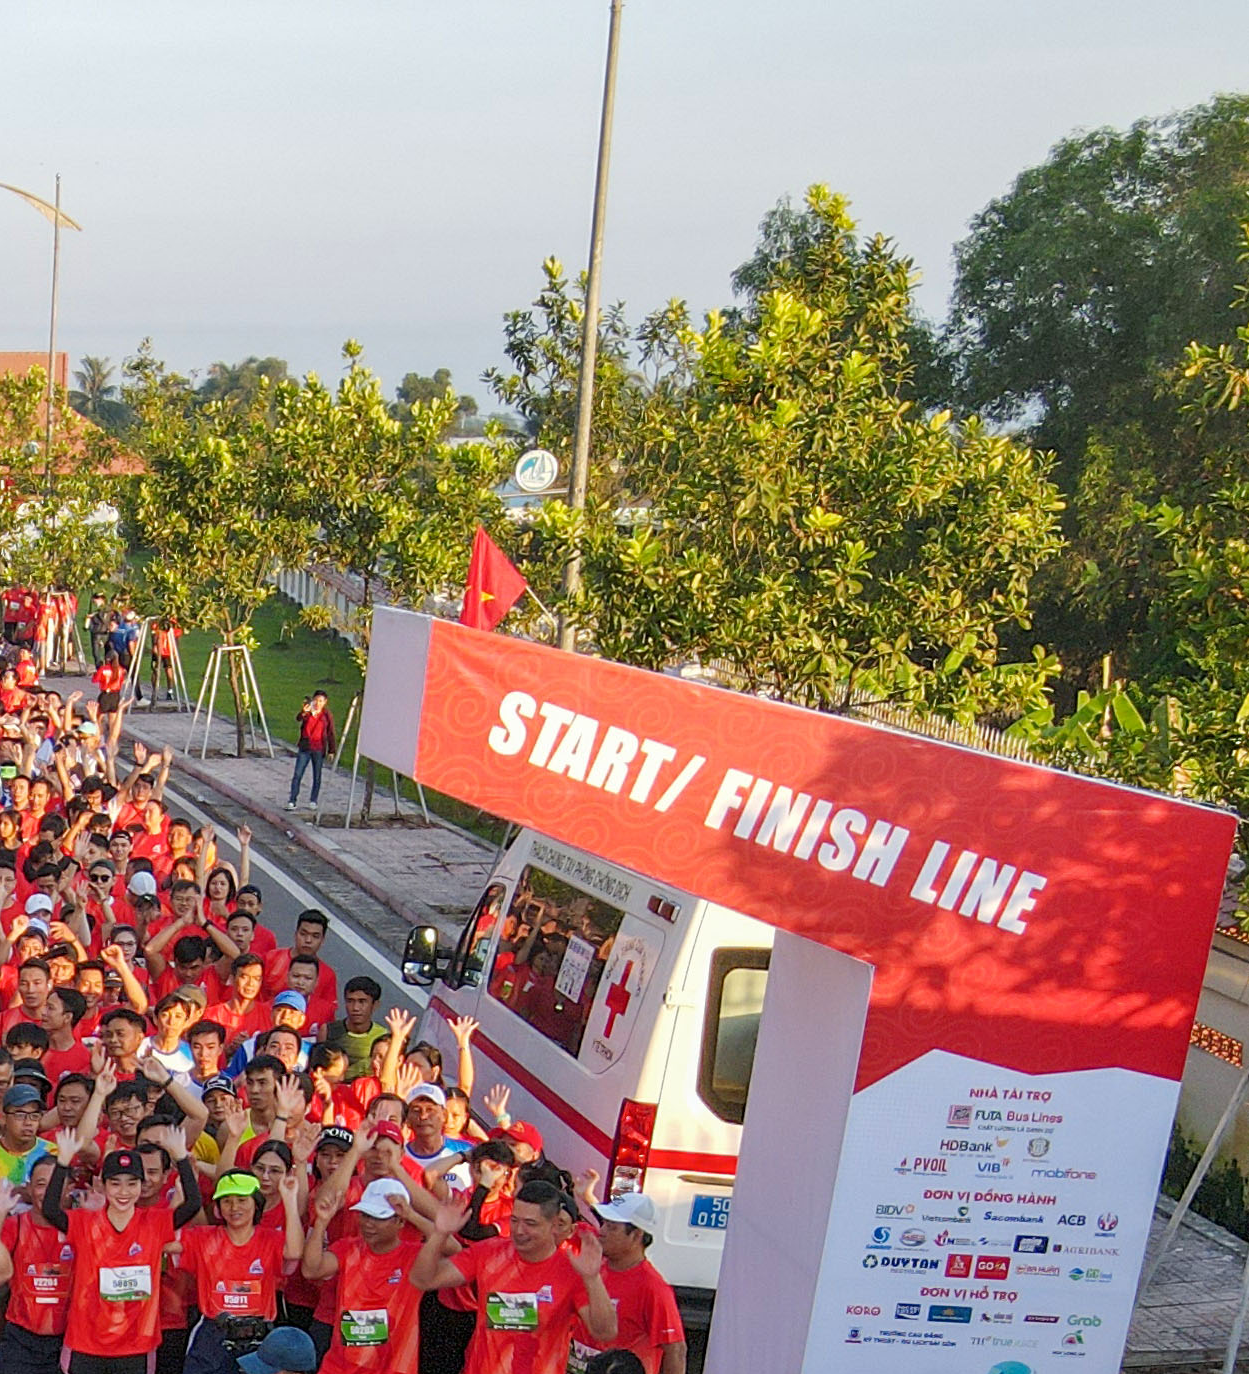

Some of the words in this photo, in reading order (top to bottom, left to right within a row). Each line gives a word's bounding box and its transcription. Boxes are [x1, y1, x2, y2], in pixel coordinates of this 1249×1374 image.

[489, 691, 705, 812] START/
[705, 767, 910, 889] FINISH
[912, 840, 1048, 935] LINE
[974, 1110, 1002, 1121] FUTA
[1006, 1111, 1029, 1122] Bus
[320, 1128, 353, 1143] PORT
[940, 1139, 993, 1152] HDBank
[977, 1162, 1001, 1173] VIB
[1017, 1191, 1057, 1205] HÀNH
[697, 1212, 728, 1227] 019
[1057, 1214, 1086, 1226] ACB
[1067, 1314, 1102, 1327] Grab
